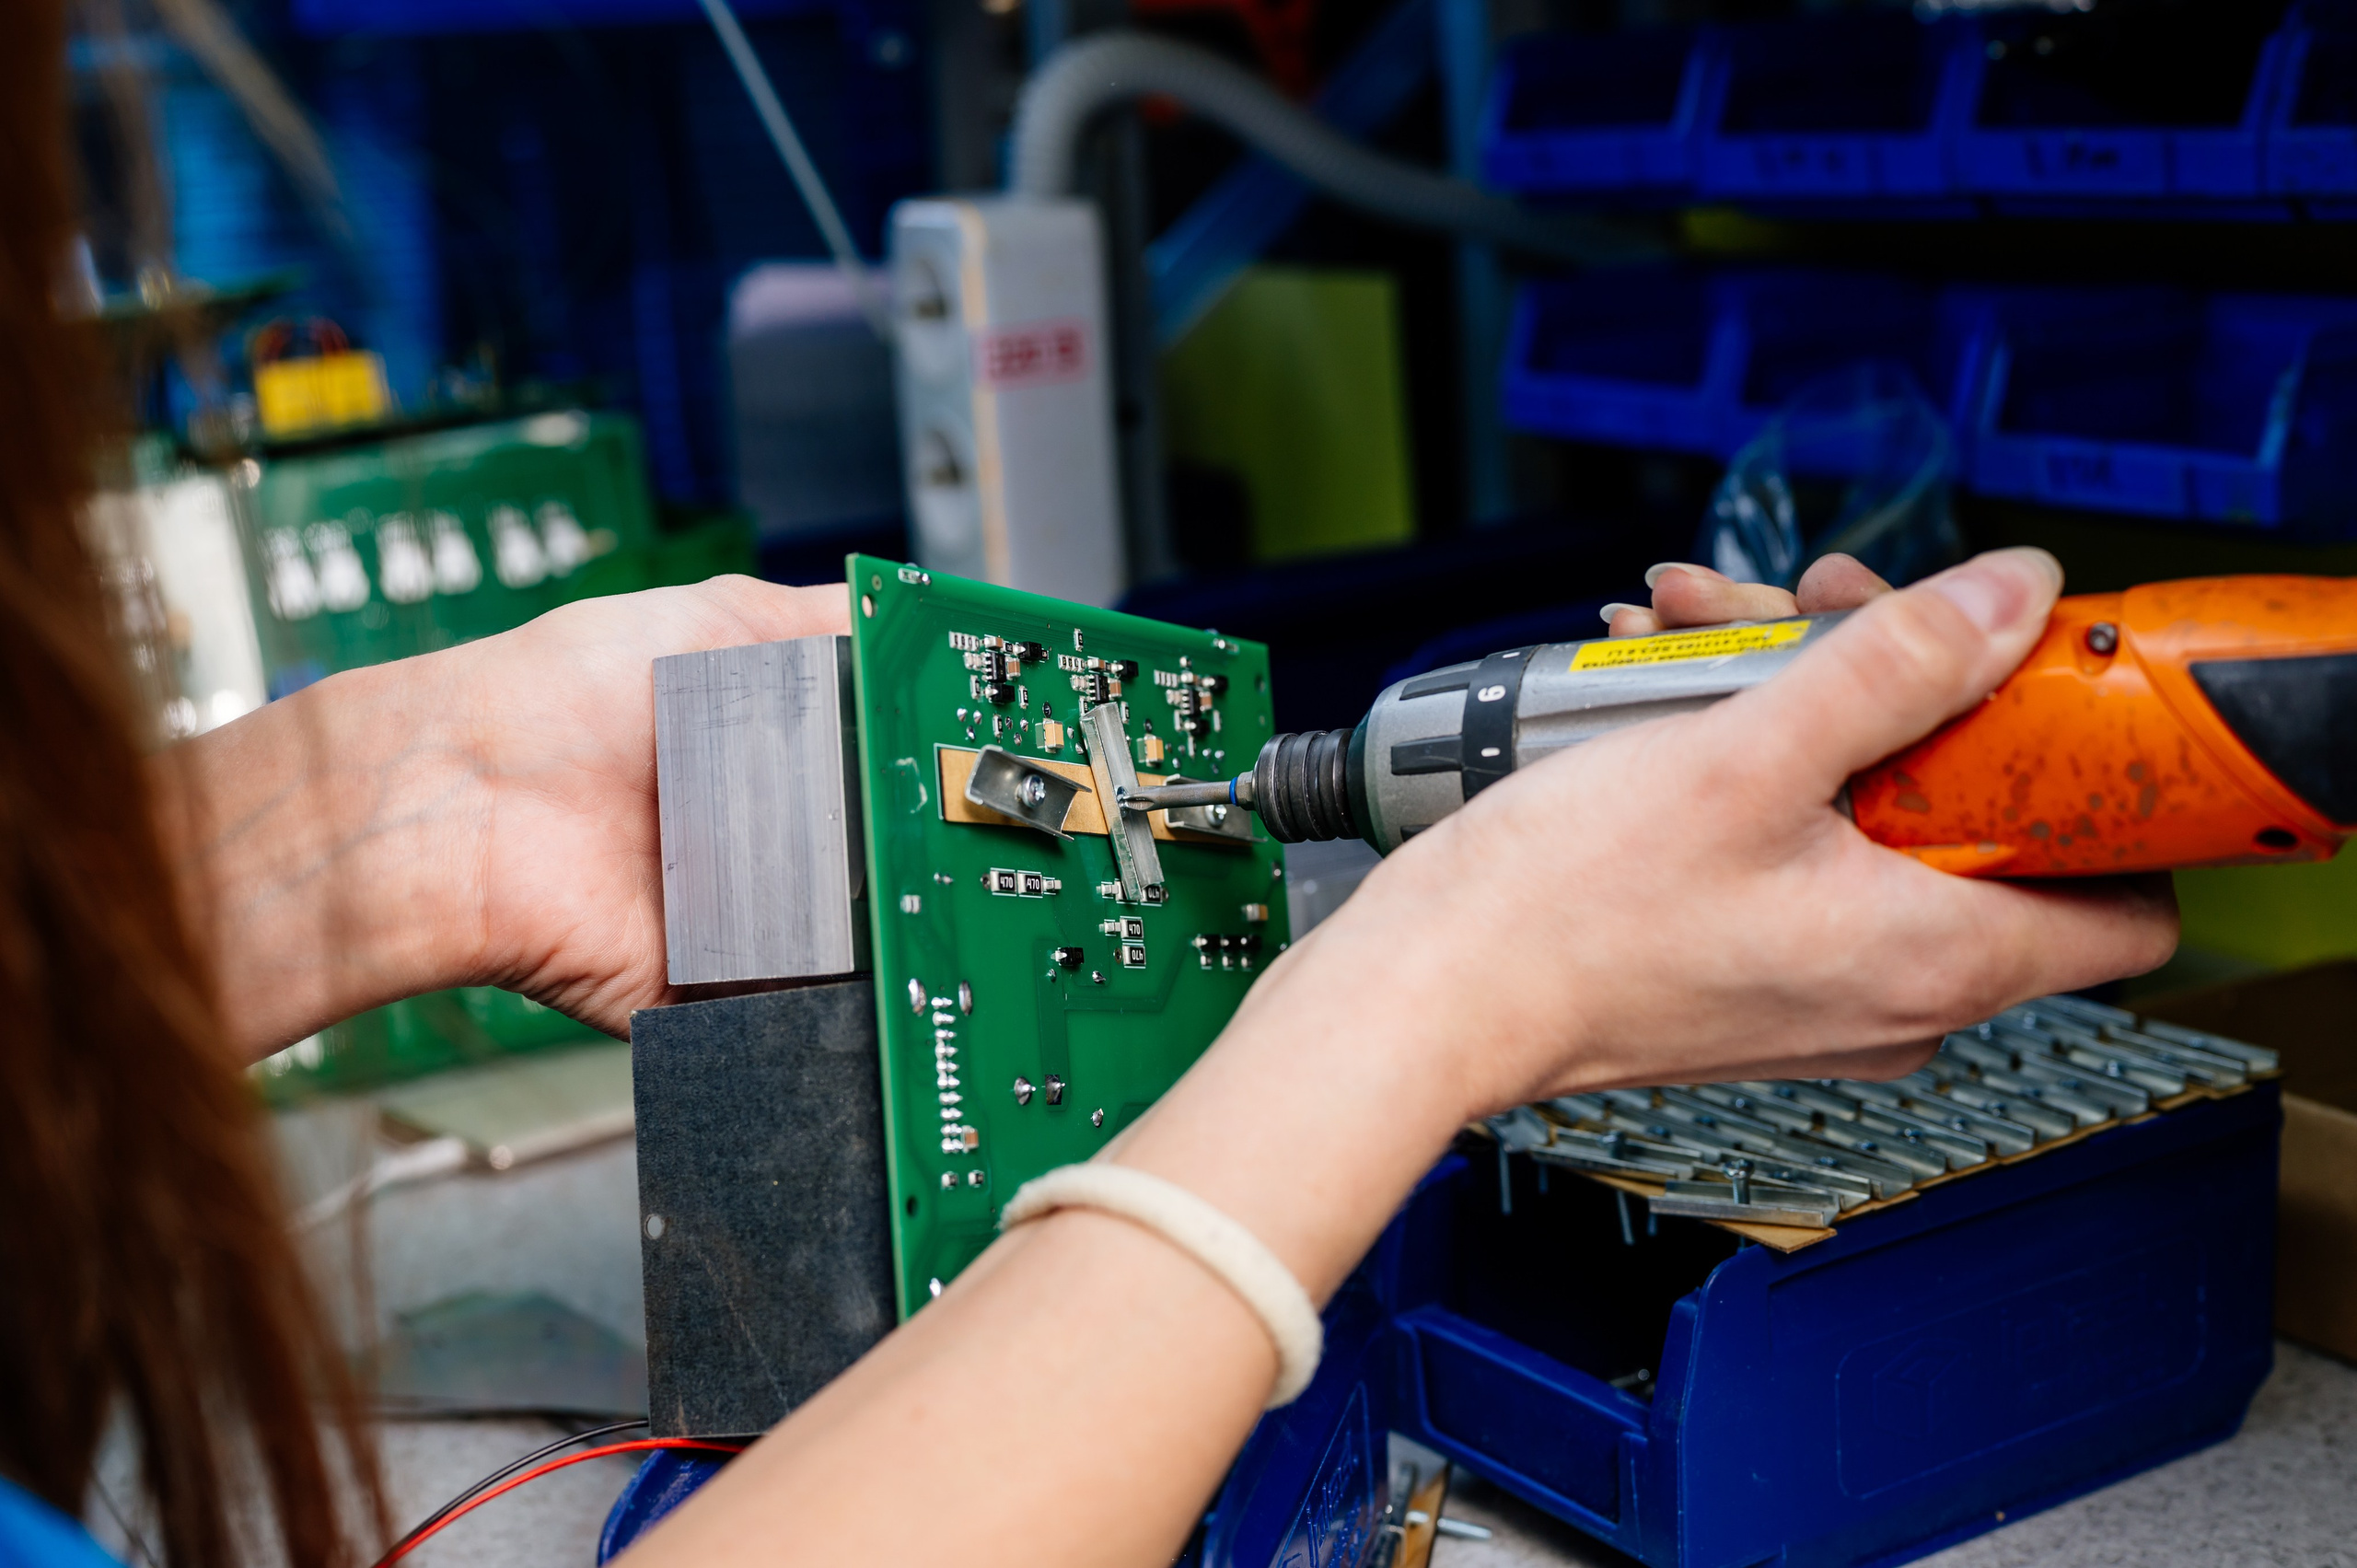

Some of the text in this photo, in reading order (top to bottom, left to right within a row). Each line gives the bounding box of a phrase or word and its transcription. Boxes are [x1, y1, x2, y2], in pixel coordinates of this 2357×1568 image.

[999, 876, 1014, 889] 470
[1026, 877, 1040, 890] 470
[1129, 923, 1141, 935] 470
[1132, 949, 1144, 960] 470
